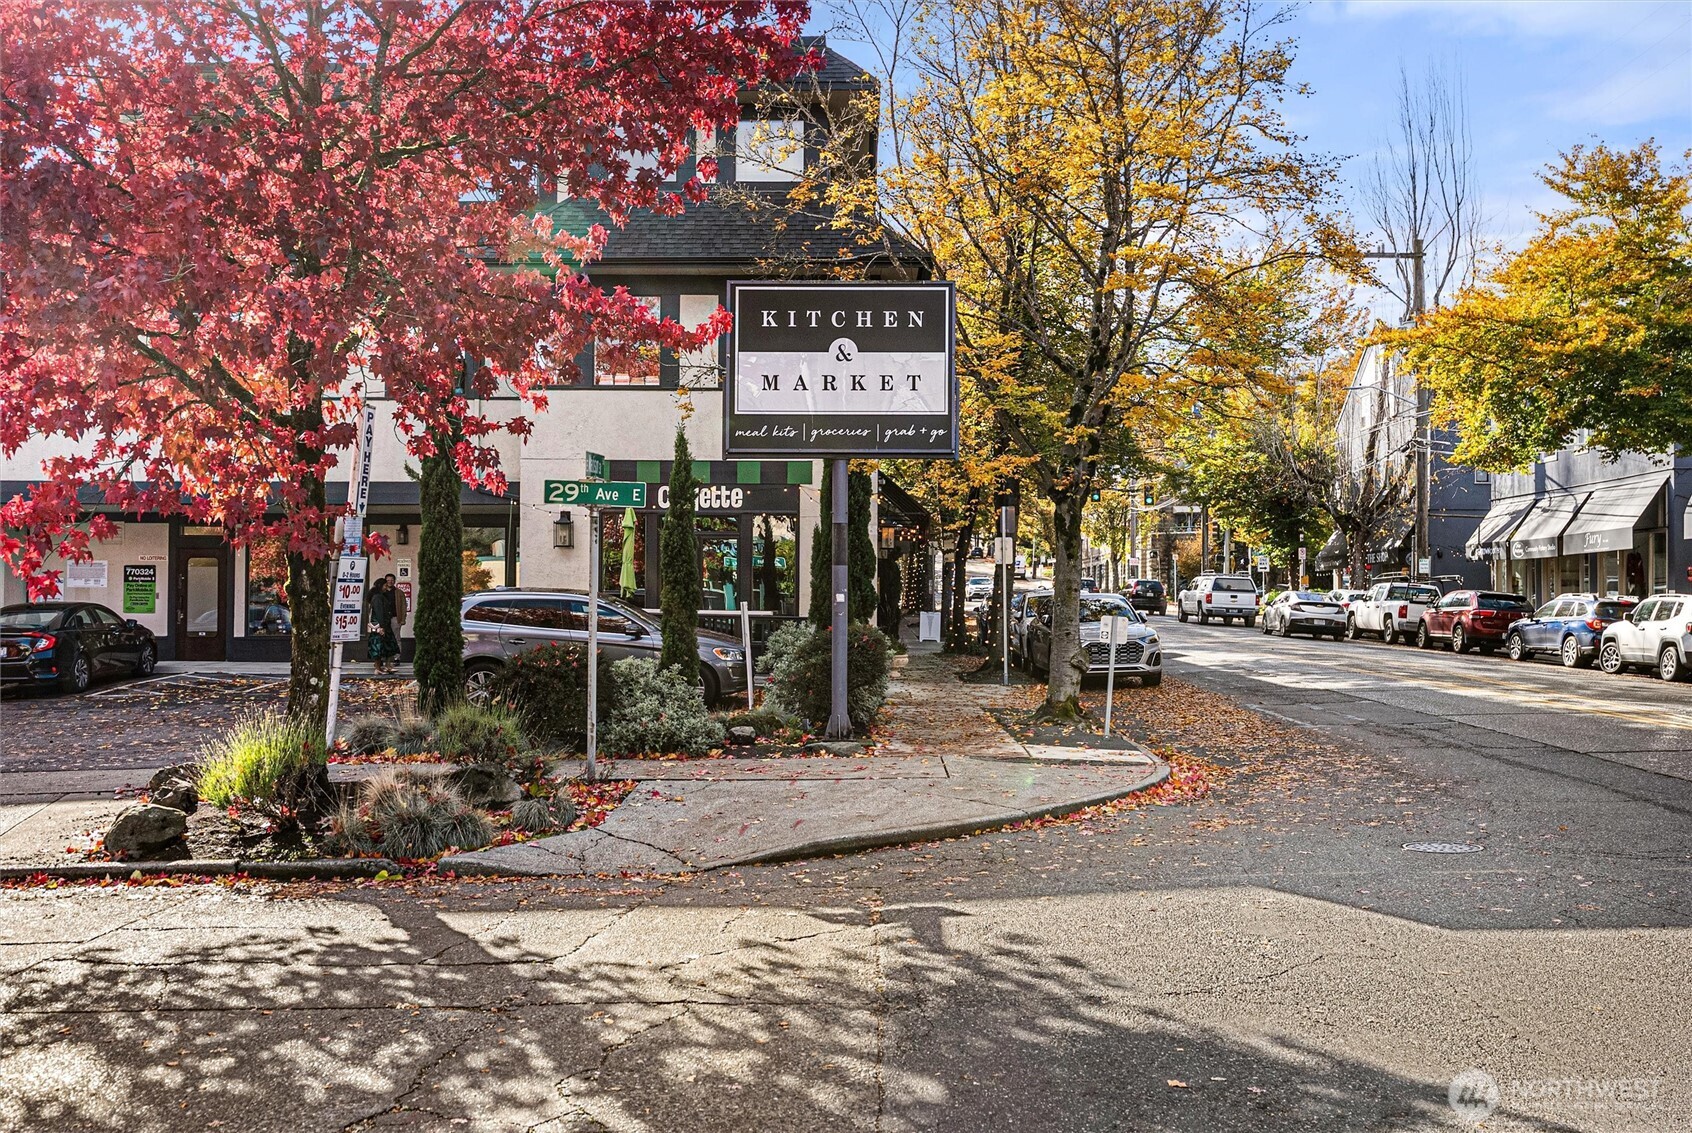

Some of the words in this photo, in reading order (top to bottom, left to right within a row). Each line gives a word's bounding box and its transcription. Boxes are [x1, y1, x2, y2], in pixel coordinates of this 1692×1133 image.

[761, 310, 924, 328] KITCHEN
[835, 343, 853, 362] &
[761, 374, 922, 391] MARKET
[365, 411, 374, 448] PAY
[735, 425, 768, 437] meal
[772, 425, 799, 437] kits
[810, 428, 871, 442] groceries
[884, 424, 916, 442] grab
[930, 428, 948, 442] go
[360, 451, 371, 499] HERE
[549, 483, 589, 502] 29th
[595, 488, 619, 501] Ave
[632, 488, 641, 501] E
[1583, 532, 1602, 548] Fury
[1367, 553, 1375, 564] THE
[339, 584, 360, 599] $10.00
[335, 615, 358, 630] $15.00
